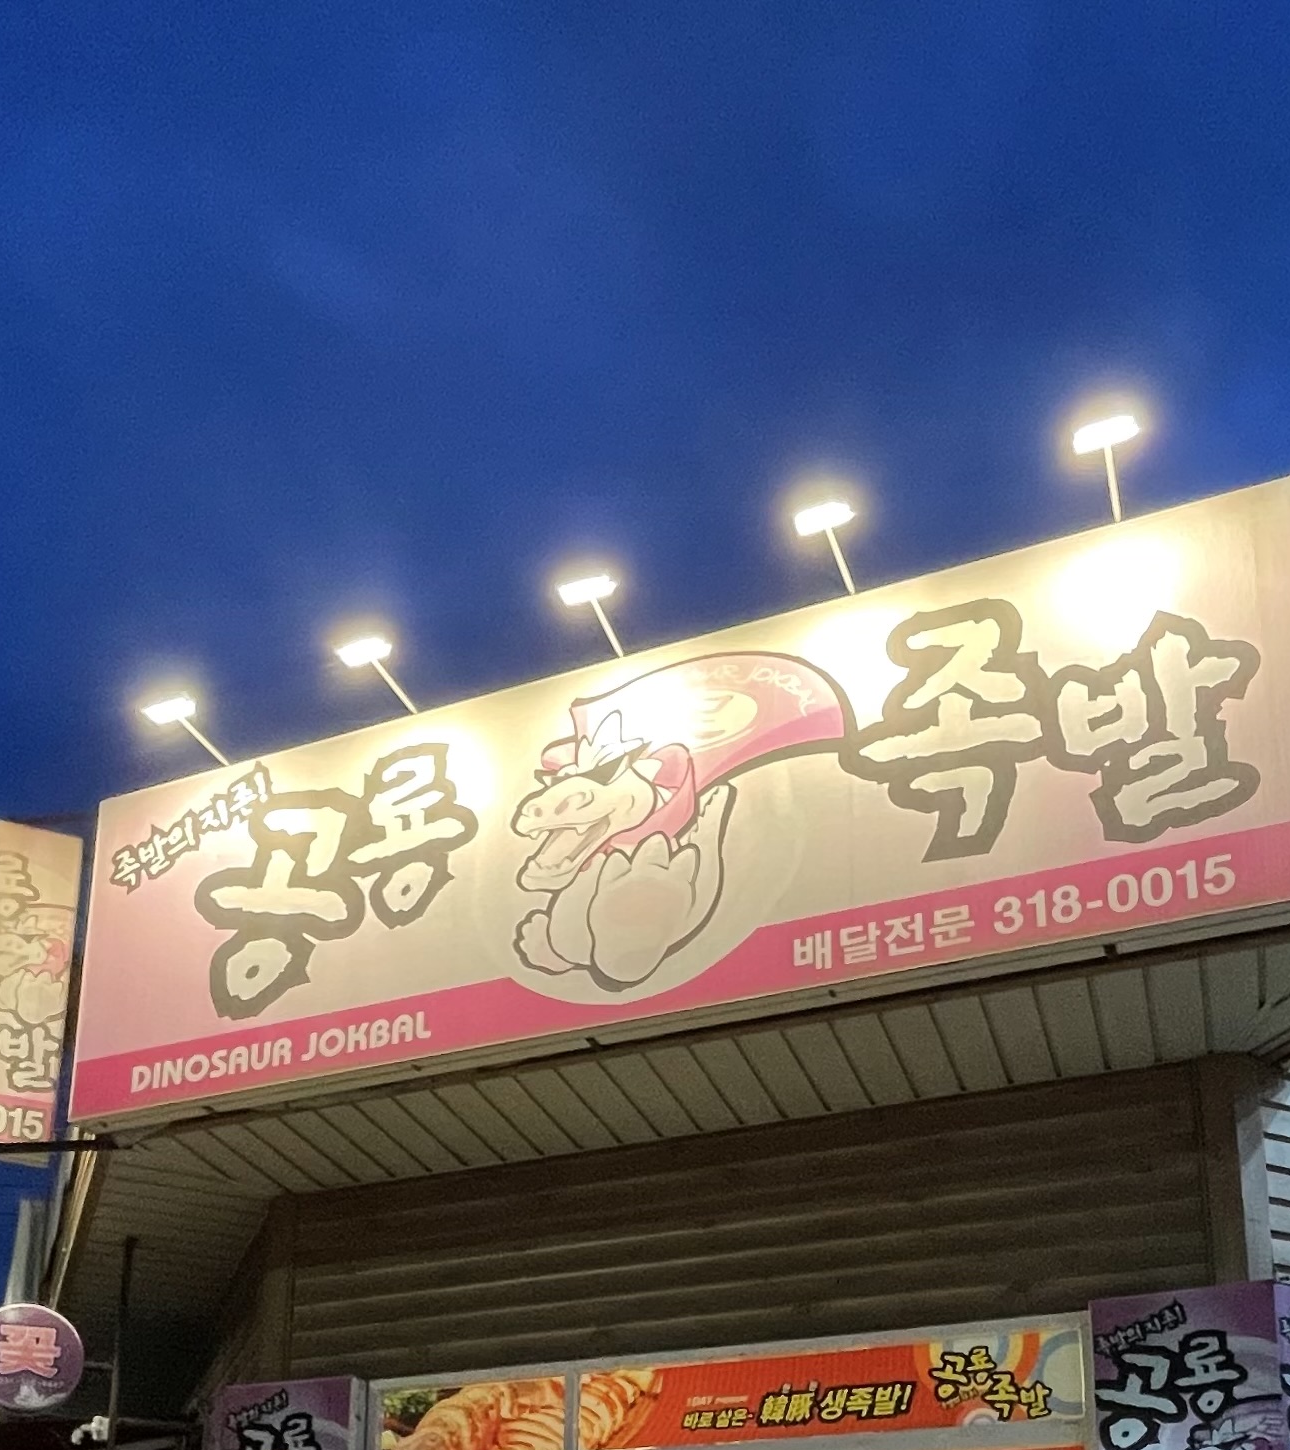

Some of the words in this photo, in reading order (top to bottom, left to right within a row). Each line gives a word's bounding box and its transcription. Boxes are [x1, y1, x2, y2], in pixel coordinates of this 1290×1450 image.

[841, 598, 1261, 862] 족발
[111, 824, 199, 893] 족발의
[199, 762, 274, 838] 지존!
[195, 742, 479, 1020] 공룡
[792, 905, 975, 970] 배달전문
[993, 854, 1236, 936] 318-0015
[130, 1043, 292, 1095] DINOSAUR
[301, 1012, 431, 1063] JOKBAL
[683, 1410, 714, 1430] 바로
[819, 1383, 913, 1422] 생족발!
[928, 1346, 997, 1402] 공룡
[982, 1371, 1052, 1422] 족발
